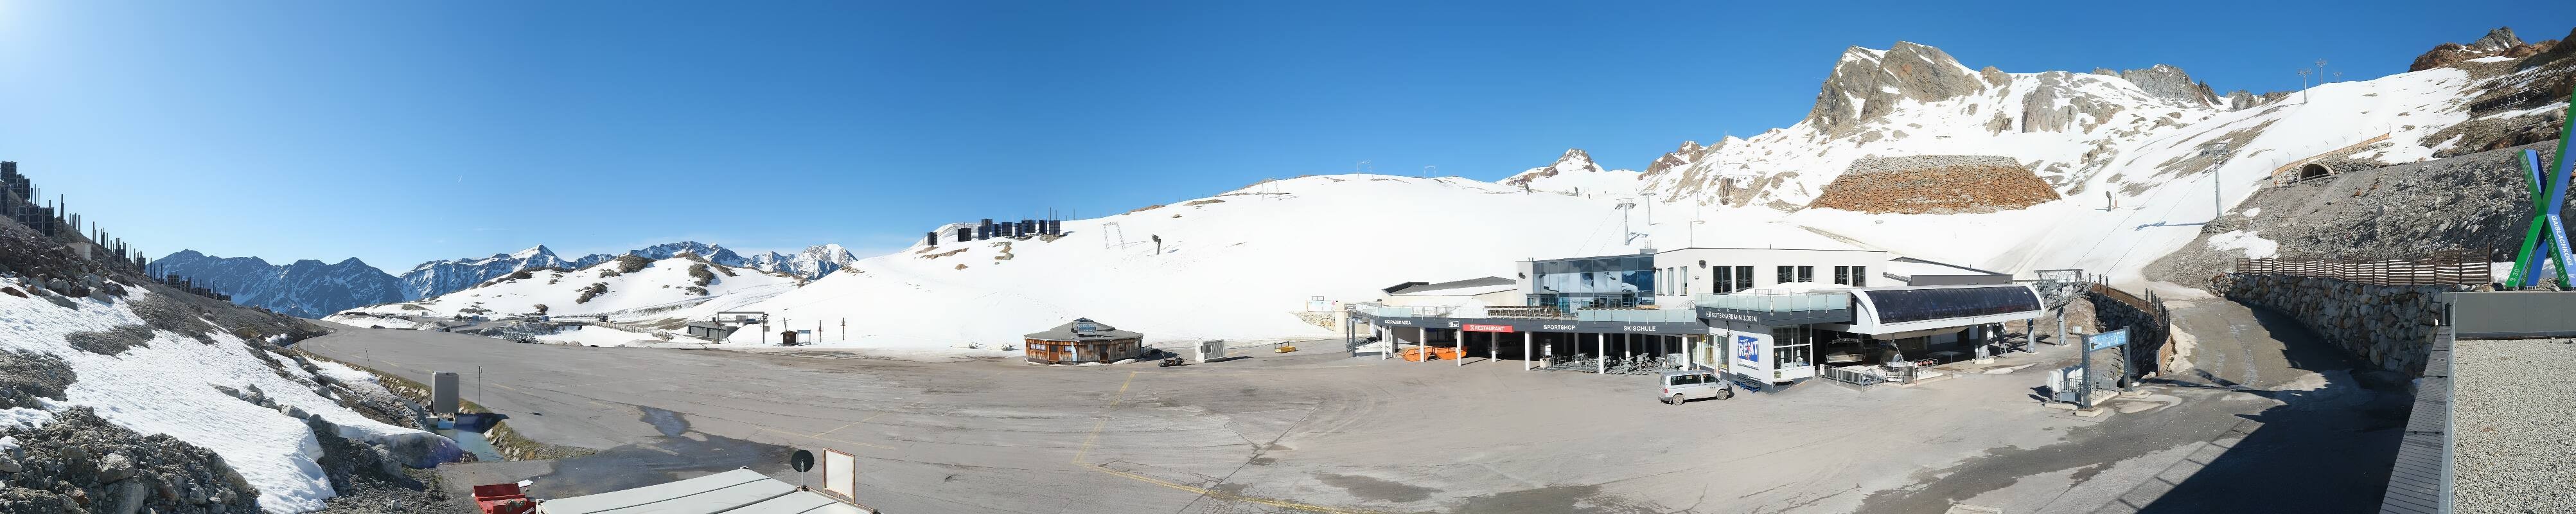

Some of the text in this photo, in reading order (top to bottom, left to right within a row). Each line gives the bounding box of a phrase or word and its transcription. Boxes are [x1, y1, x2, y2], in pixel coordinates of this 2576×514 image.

[2520, 154, 2534, 184] BIG 3
[1738, 341, 1758, 357] RENT
